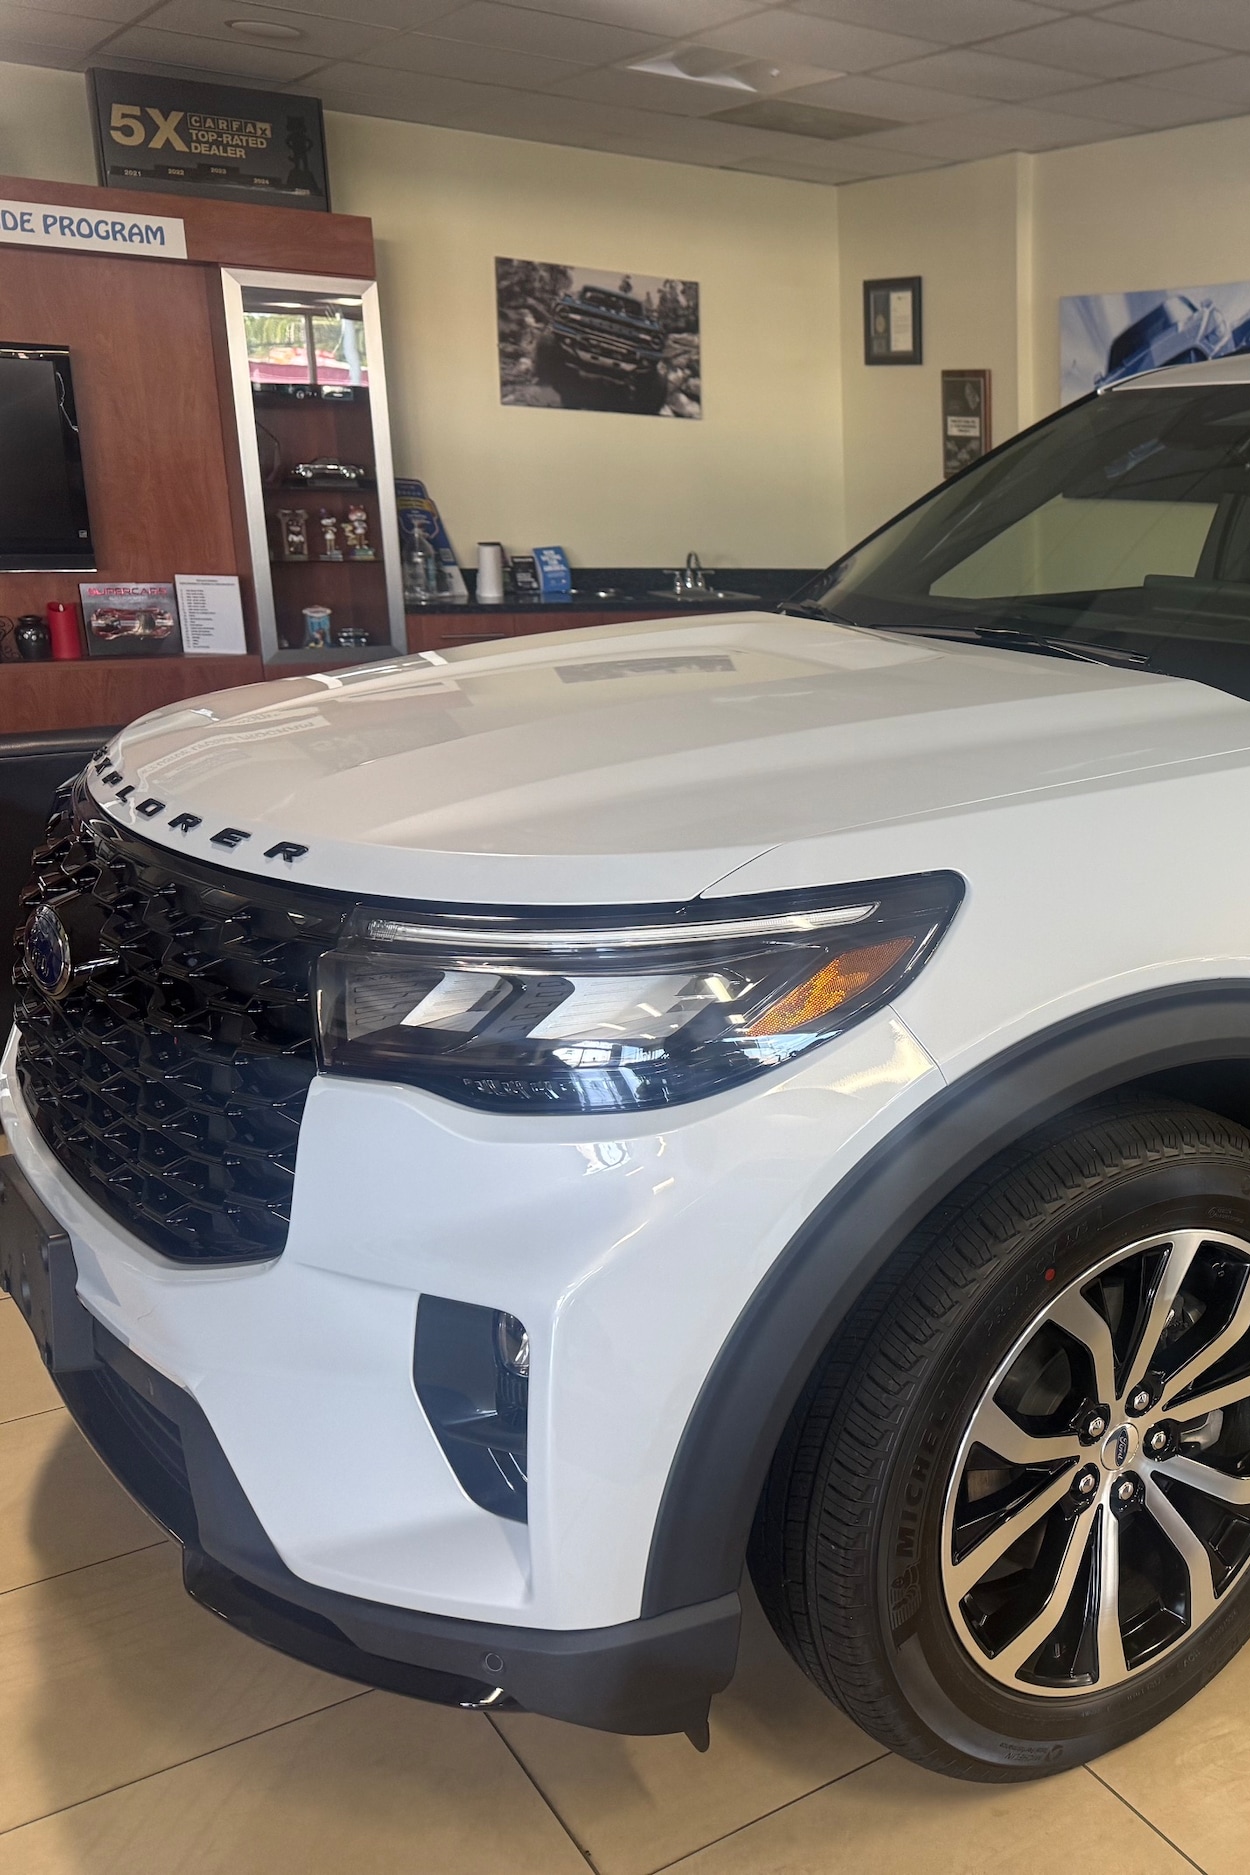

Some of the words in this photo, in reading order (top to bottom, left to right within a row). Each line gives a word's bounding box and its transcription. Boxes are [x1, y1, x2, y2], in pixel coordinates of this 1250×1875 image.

[109, 103, 190, 153] 5X
[189, 114, 271, 138] CARFAX
[189, 129, 267, 148] TOP-RATED
[190, 142, 246, 158] DEALER
[124, 169, 142, 177] 2021
[0, 210, 36, 233] DE
[42, 214, 166, 246] PROGRAM
